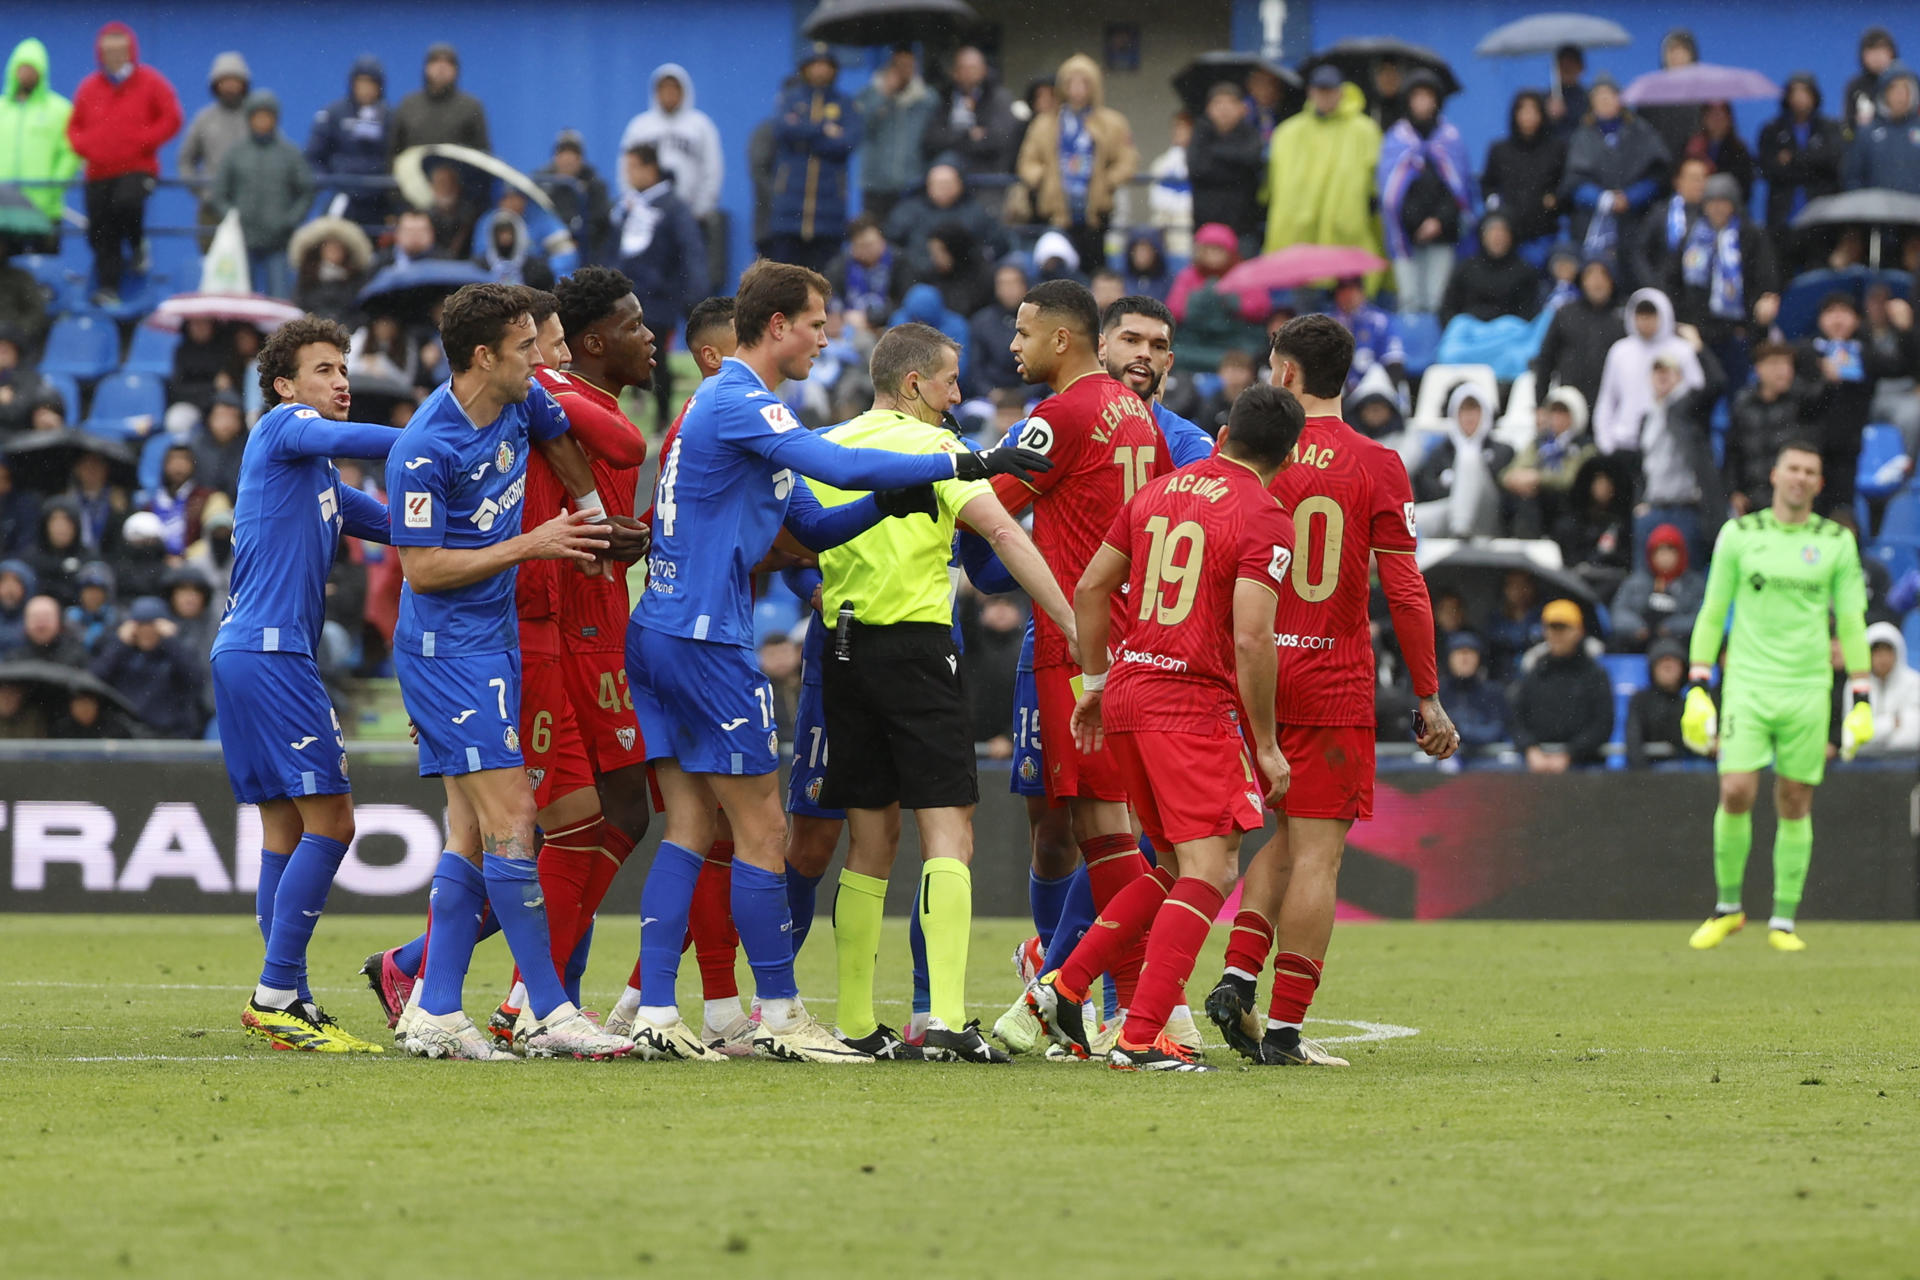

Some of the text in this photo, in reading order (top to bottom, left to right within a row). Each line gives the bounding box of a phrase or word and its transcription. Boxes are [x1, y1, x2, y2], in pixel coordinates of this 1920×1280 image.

[1021, 426, 1049, 449] JD
[1164, 474, 1229, 503] ACUÑA
[1139, 515, 1205, 626] 19
[489, 678, 507, 719] 7
[532, 710, 552, 753] 6
